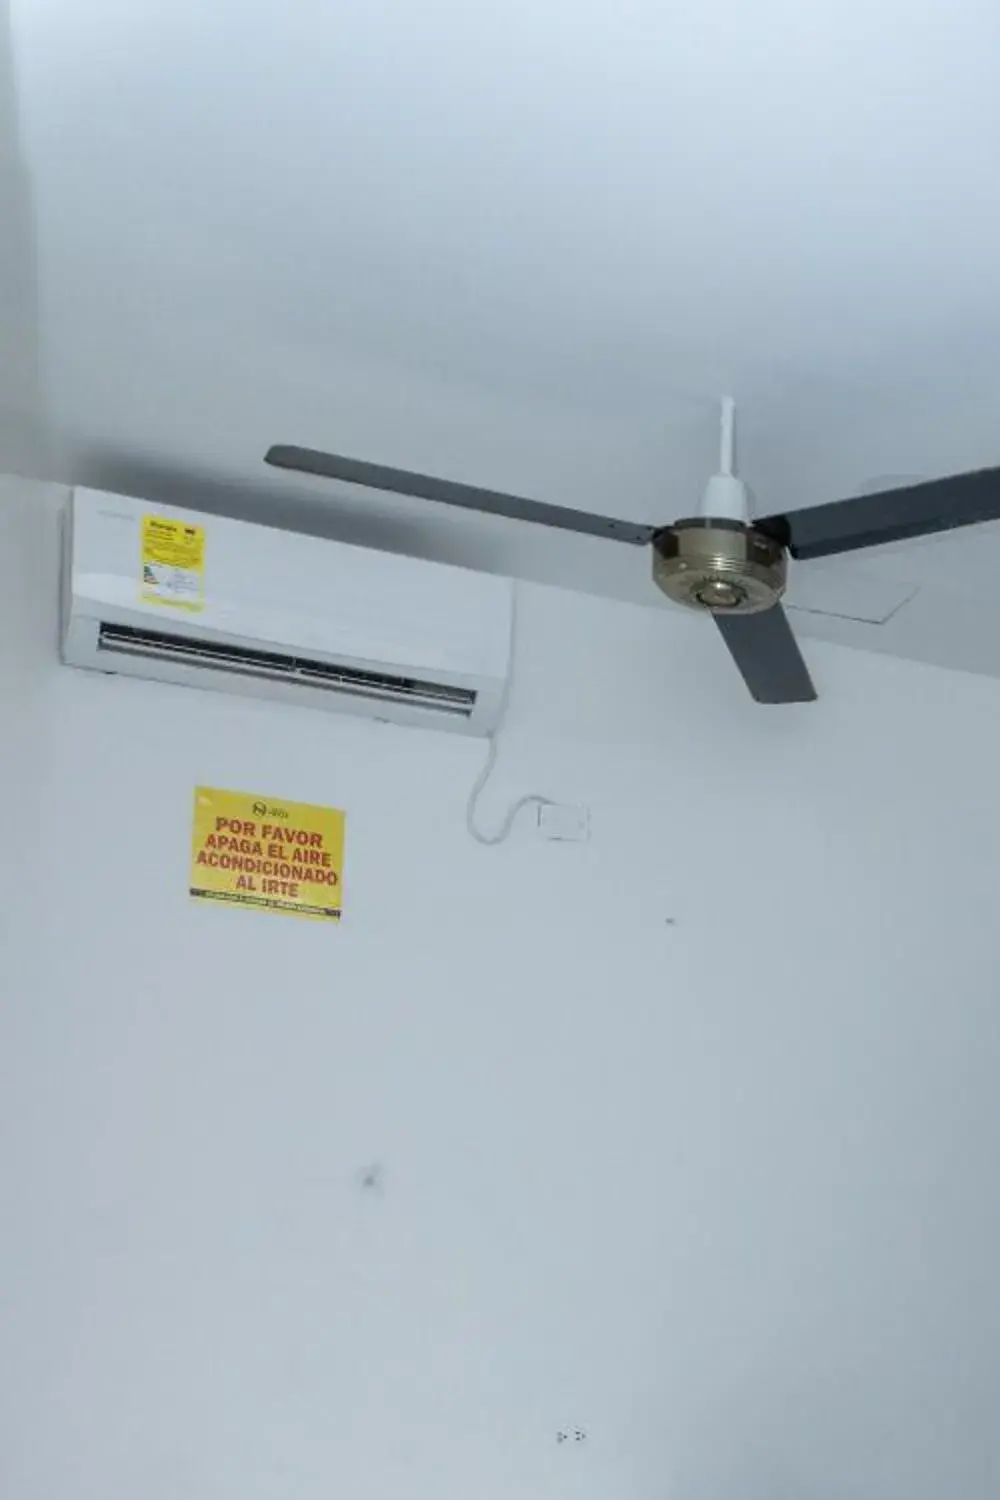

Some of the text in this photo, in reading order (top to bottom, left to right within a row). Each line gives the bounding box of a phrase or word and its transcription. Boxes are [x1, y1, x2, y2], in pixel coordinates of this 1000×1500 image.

[216, 817, 323, 848] POR FAVOR
[205, 834, 331, 867] APAGA EL AIRE
[197, 851, 338, 886] ACONDICIONADO
[236, 875, 299, 897] AL IRTE
